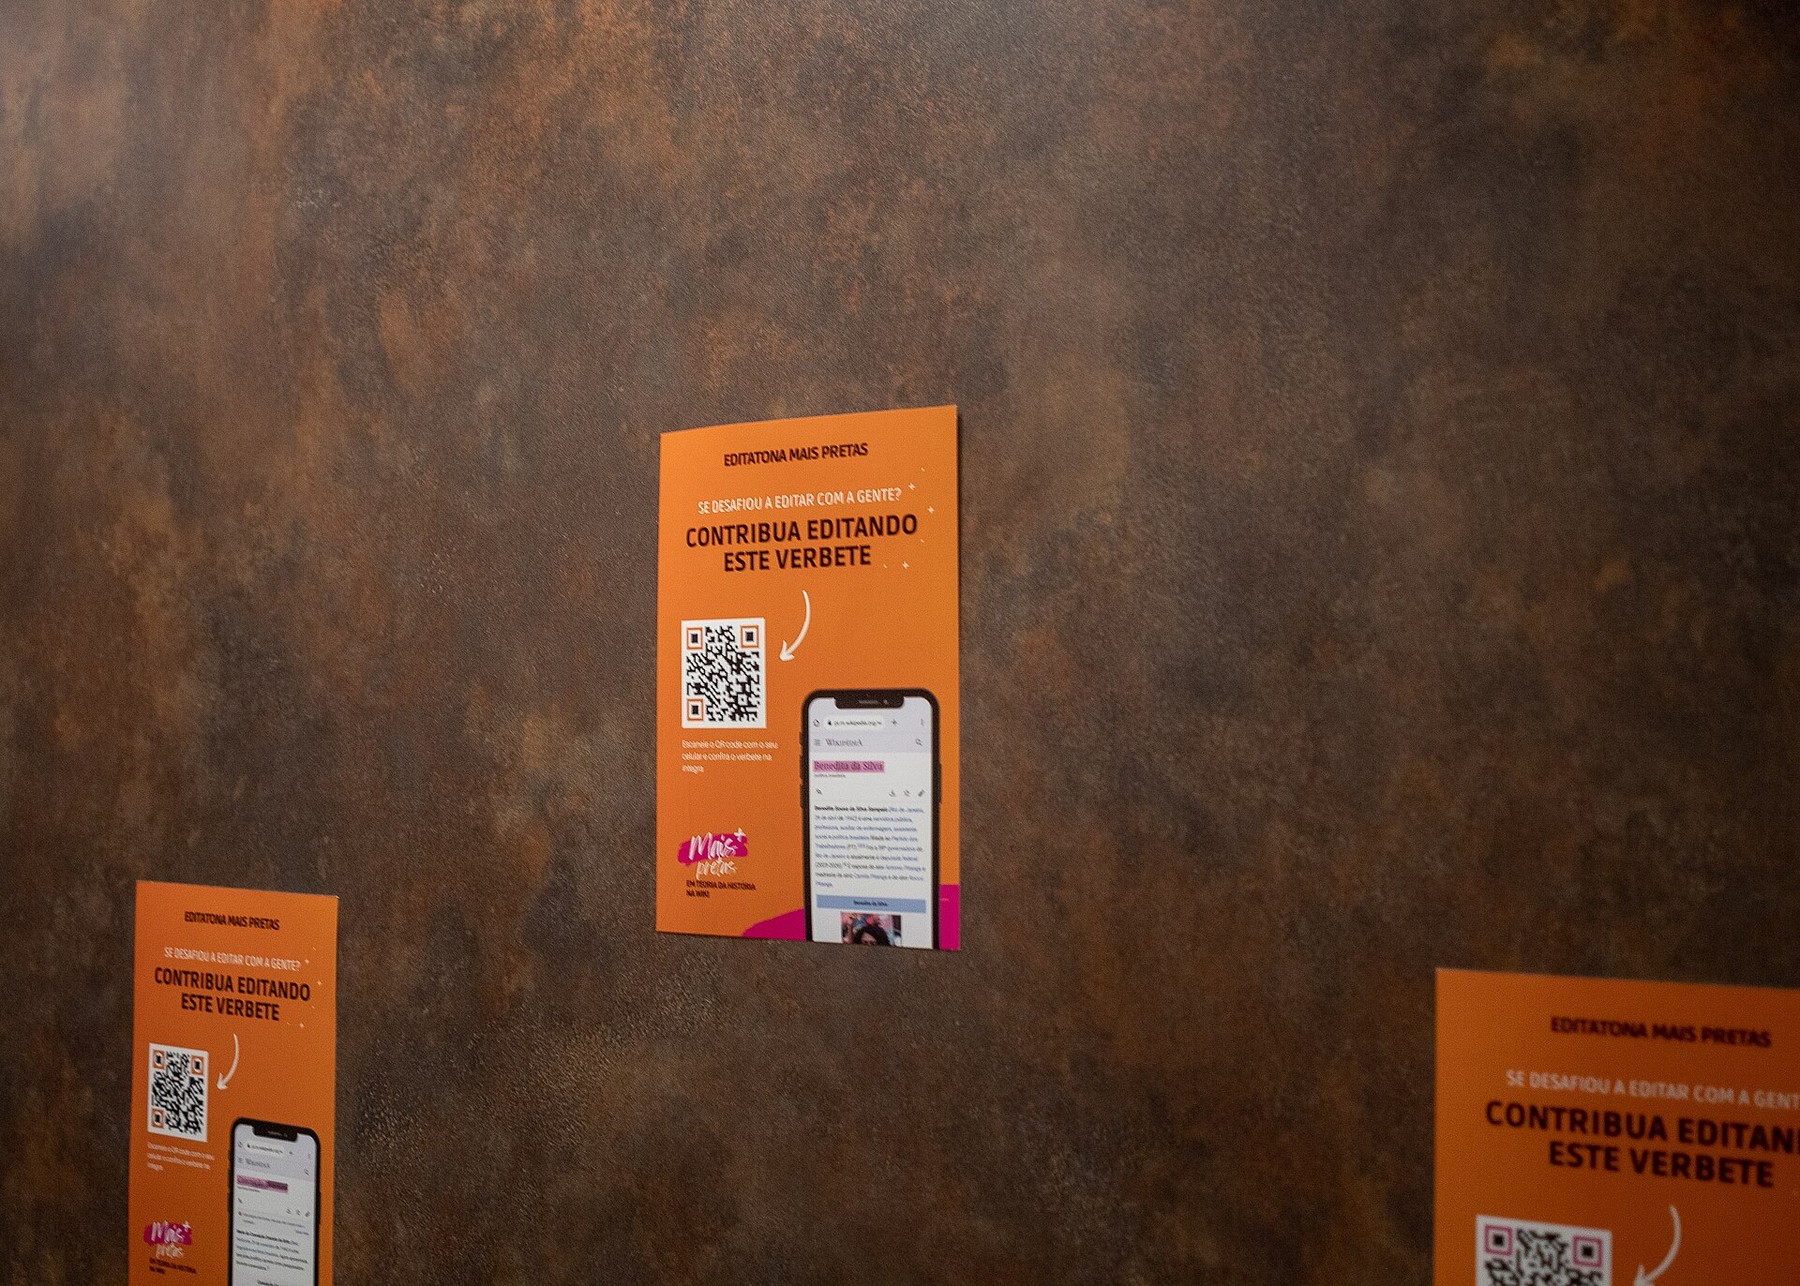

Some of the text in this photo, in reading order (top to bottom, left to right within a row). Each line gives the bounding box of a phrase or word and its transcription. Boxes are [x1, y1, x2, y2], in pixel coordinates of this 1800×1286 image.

[724, 443, 868, 467] EDITATONA MAIS PRETAS
[698, 487, 902, 514] SE DESAFIOU A EDITAR COM A GENTE?
[686, 514, 918, 548] CONTRIBUA EDITANDO
[724, 545, 871, 572] ESTE VERBETE
[863, 761, 883, 771] Silva
[184, 911, 280, 930] EDITATONA MAIS PRETAS
[164, 946, 301, 971] SE DESAFIOU A EDITAR COM A GENTE?
[154, 967, 311, 1001] CONTRIBUA EDITANDO
[181, 993, 280, 1021] ESTE VERBETE
[1551, 1016, 1772, 1048] EDITATONA MAIS PRETAS
[1506, 1069, 1525, 1088] SE
[1529, 1071, 1611, 1094] DESAFIOU
[1613, 1080, 1626, 1095] A
[1629, 1080, 1689, 1100] EDITAR
[1693, 1085, 1734, 1104] COM
[1737, 1089, 1750, 1105] A
[1485, 1100, 1668, 1142] CONTRIBUA
[1550, 1141, 1774, 1189] ESTE VERBETE
